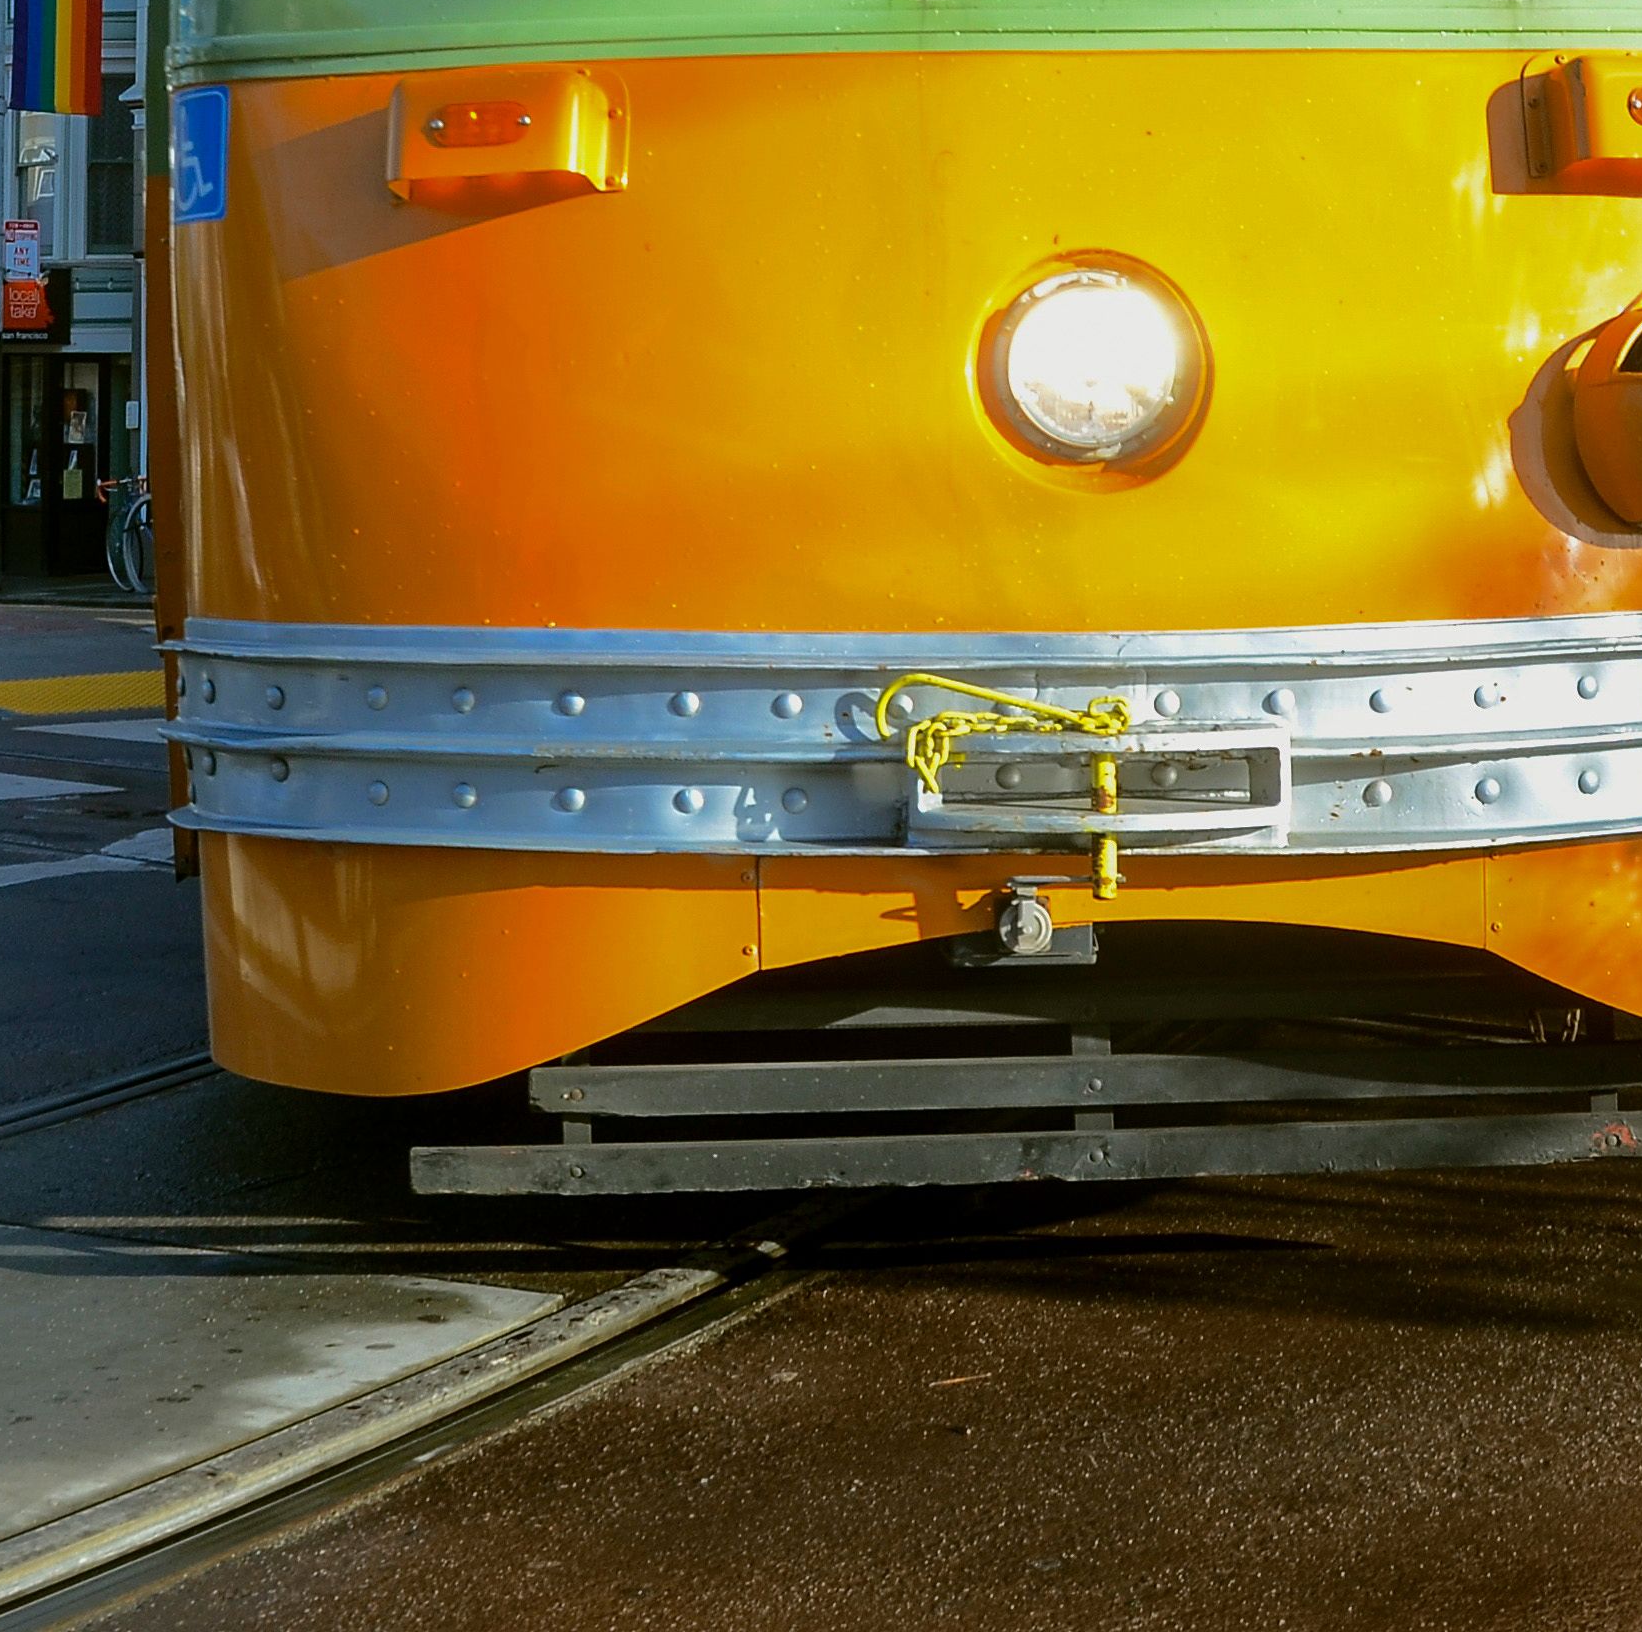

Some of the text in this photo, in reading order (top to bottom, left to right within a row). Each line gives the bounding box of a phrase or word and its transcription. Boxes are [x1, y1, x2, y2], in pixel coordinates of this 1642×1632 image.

[14, 247, 29, 256] ANY
[13, 258, 31, 267] TIME
[9, 288, 38, 301] local
[10, 305, 37, 318] take
[16, 332, 48, 340] francisco
